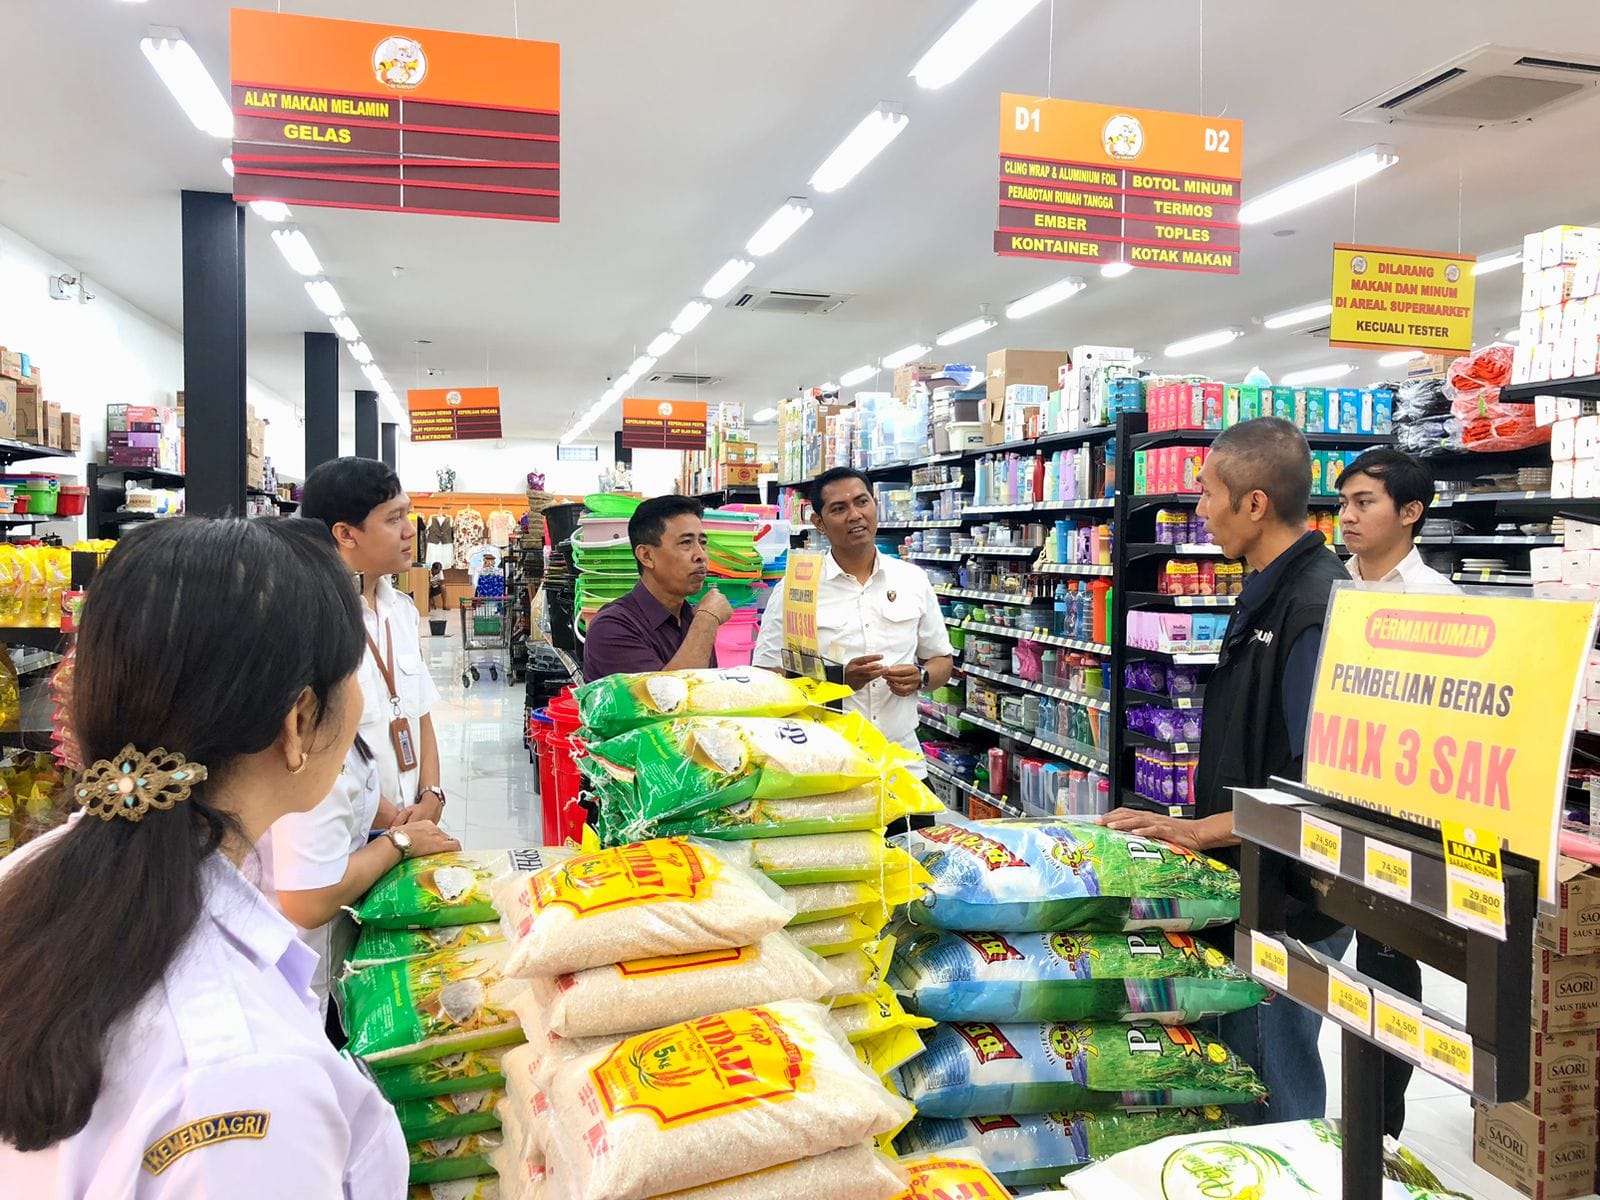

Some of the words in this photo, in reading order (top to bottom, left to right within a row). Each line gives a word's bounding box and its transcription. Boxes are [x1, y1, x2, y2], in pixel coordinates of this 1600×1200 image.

[244, 91, 278, 108] ALAT
[280, 94, 328, 113] MAKAN
[331, 99, 389, 118] MELAMIN
[1015, 106, 1040, 132] D1
[283, 124, 351, 144] GELAS
[1205, 128, 1230, 153] D2
[1004, 160, 1027, 176] CLING
[1029, 164, 1050, 178] WRAP
[1051, 167, 1057, 179] &
[1058, 167, 1100, 185] ALUMINIUM
[1101, 173, 1118, 186] FOIL
[1132, 176, 1180, 192] BOTOL
[1184, 179, 1233, 197] MINUM
[1008, 185, 1053, 203] PERABOTAN
[1055, 190, 1082, 206] RUMAH
[1083, 194, 1114, 209] TANGGA
[1154, 201, 1213, 219] TERMOS
[1034, 214, 1087, 232] EMBER
[1155, 225, 1210, 242] TOPLES
[1011, 236, 1099, 256] KONTAINER
[1131, 247, 1179, 263] KOTAK
[1182, 251, 1232, 267] MAKAN
[1378, 262, 1434, 278] DILARANG
[1351, 279, 1392, 294] MAKAN
[1395, 282, 1418, 295] DAN
[1420, 285, 1458, 299] MINUM
[1335, 297, 1347, 308] DI
[1350, 298, 1387, 311] AREAL
[1390, 301, 1471, 318] SUPERMARKET
[1356, 320, 1405, 335] KECUALI
[1408, 325, 1449, 337] TESTER
[786, 610, 798, 635] MAX
[799, 614, 803, 637] 3
[803, 615, 816, 640] SAK
[1370, 617, 1490, 649] PERMAKLUMAN
[1331, 663, 1437, 706] PEMBELIAN
[1438, 677, 1514, 717] BERAS
[1309, 711, 1388, 780] MAX
[1394, 728, 1421, 787] 3
[1429, 735, 1517, 812] SAK
[1315, 834, 1337, 850] 74,500
[1452, 842, 1492, 865] MAAF
[1381, 861, 1407, 878] 74,500
[1449, 856, 1473, 872] BARANG
[1474, 865, 1499, 880] KOSONG
[1468, 889, 1500, 908] 29,800
[1559, 980, 1593, 994] SAORI
[1554, 1003, 1573, 1013] SAUS
[1574, 1001, 1599, 1010] TIRAM
[1391, 1015, 1417, 1035] 74,500
[1438, 1039, 1467, 1060] 29,800
[1551, 1063, 1586, 1077] SAORI
[1547, 1085, 1565, 1094] SAUS
[1567, 1083, 1590, 1092] TIRAM
[145, 1114, 262, 1170] KEMENDAGRI
[1489, 1126, 1523, 1157] SAORI
[1488, 1146, 1504, 1161] SAUS
[1554, 1149, 1586, 1163] SAORI
